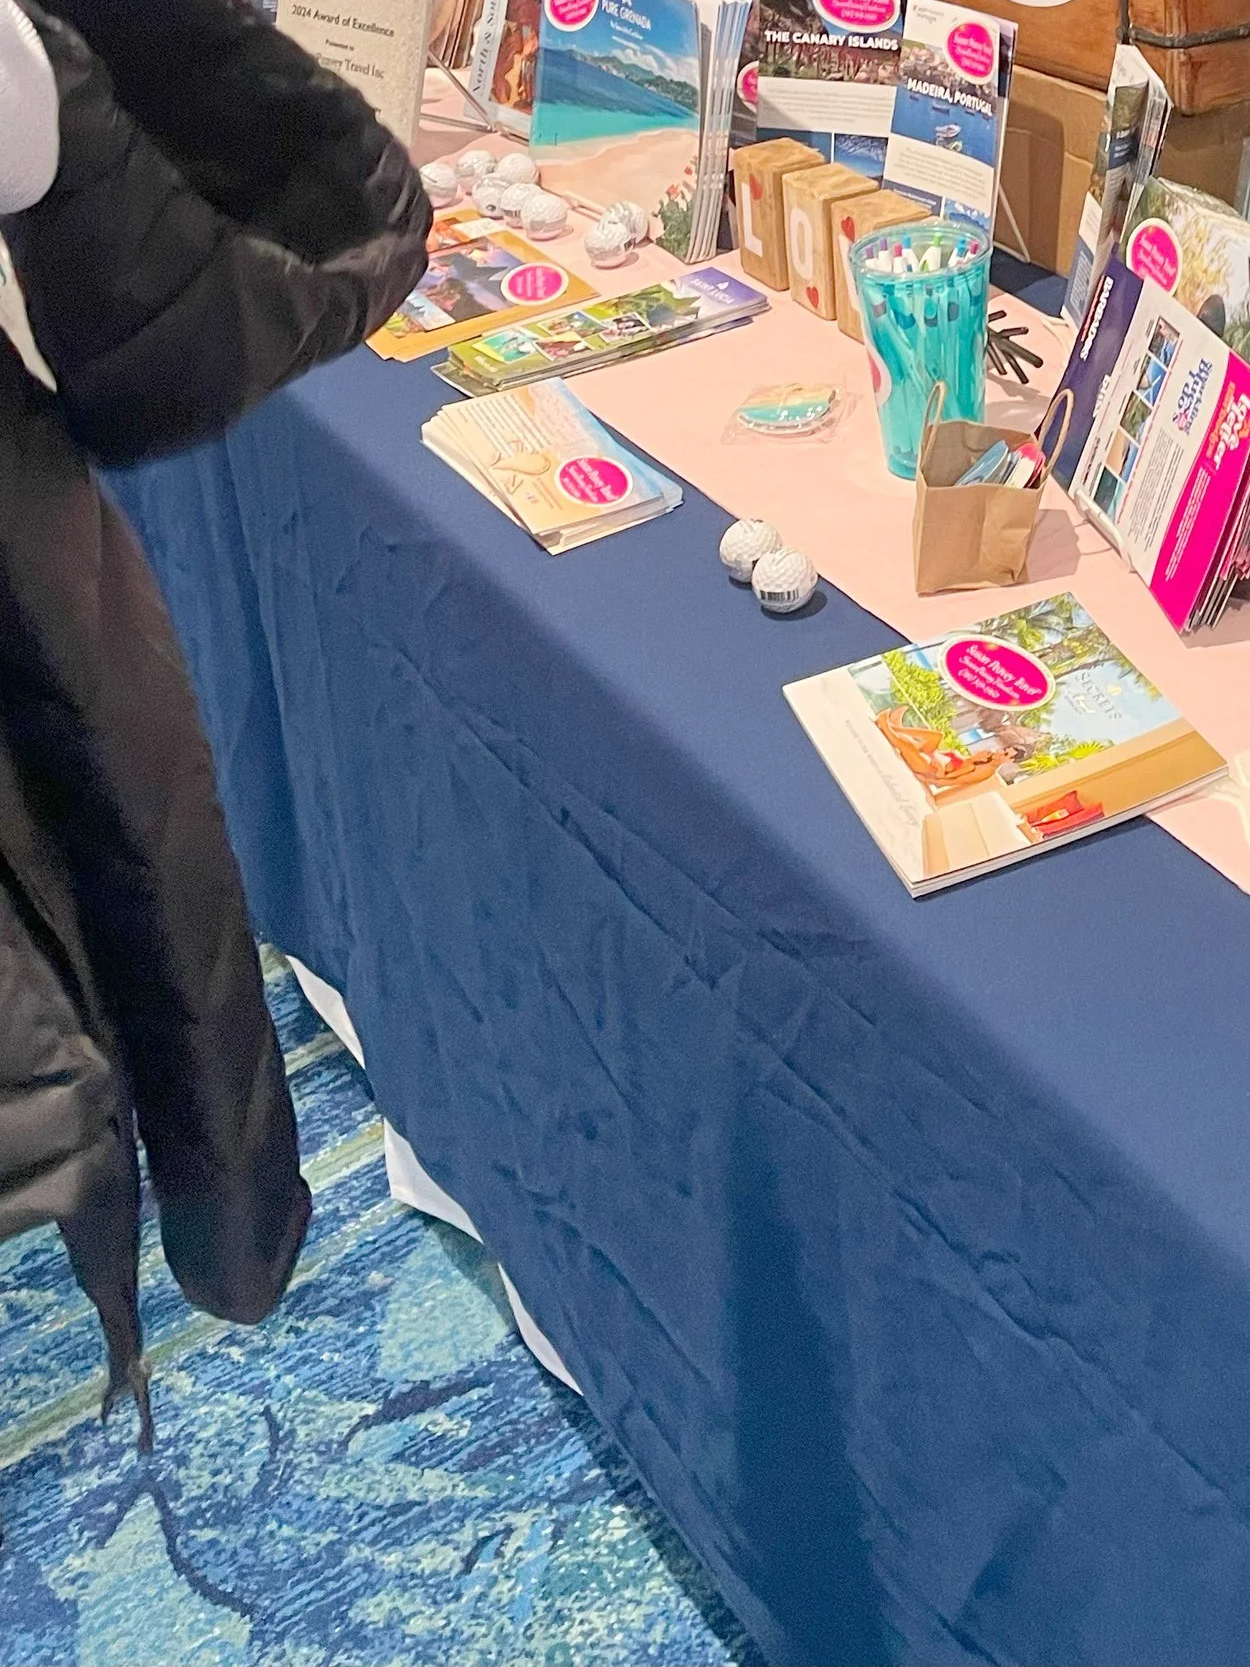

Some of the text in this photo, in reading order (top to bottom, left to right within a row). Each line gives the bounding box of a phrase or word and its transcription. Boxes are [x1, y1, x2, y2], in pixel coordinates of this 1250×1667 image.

[292, 4, 394, 37] 2024 Award of Excellence
[619, 6, 652, 31] GRENADA
[764, 30, 899, 51] THE CANARY ISLANDS
[345, 59, 370, 75] Travel
[473, 49, 489, 92] North
[907, 78, 953, 105] MADEIRA,
[954, 92, 993, 117] PORTUGAL
[737, 182, 763, 258] L
[790, 206, 813, 281] O
[1079, 275, 1114, 361] BARBADOS
